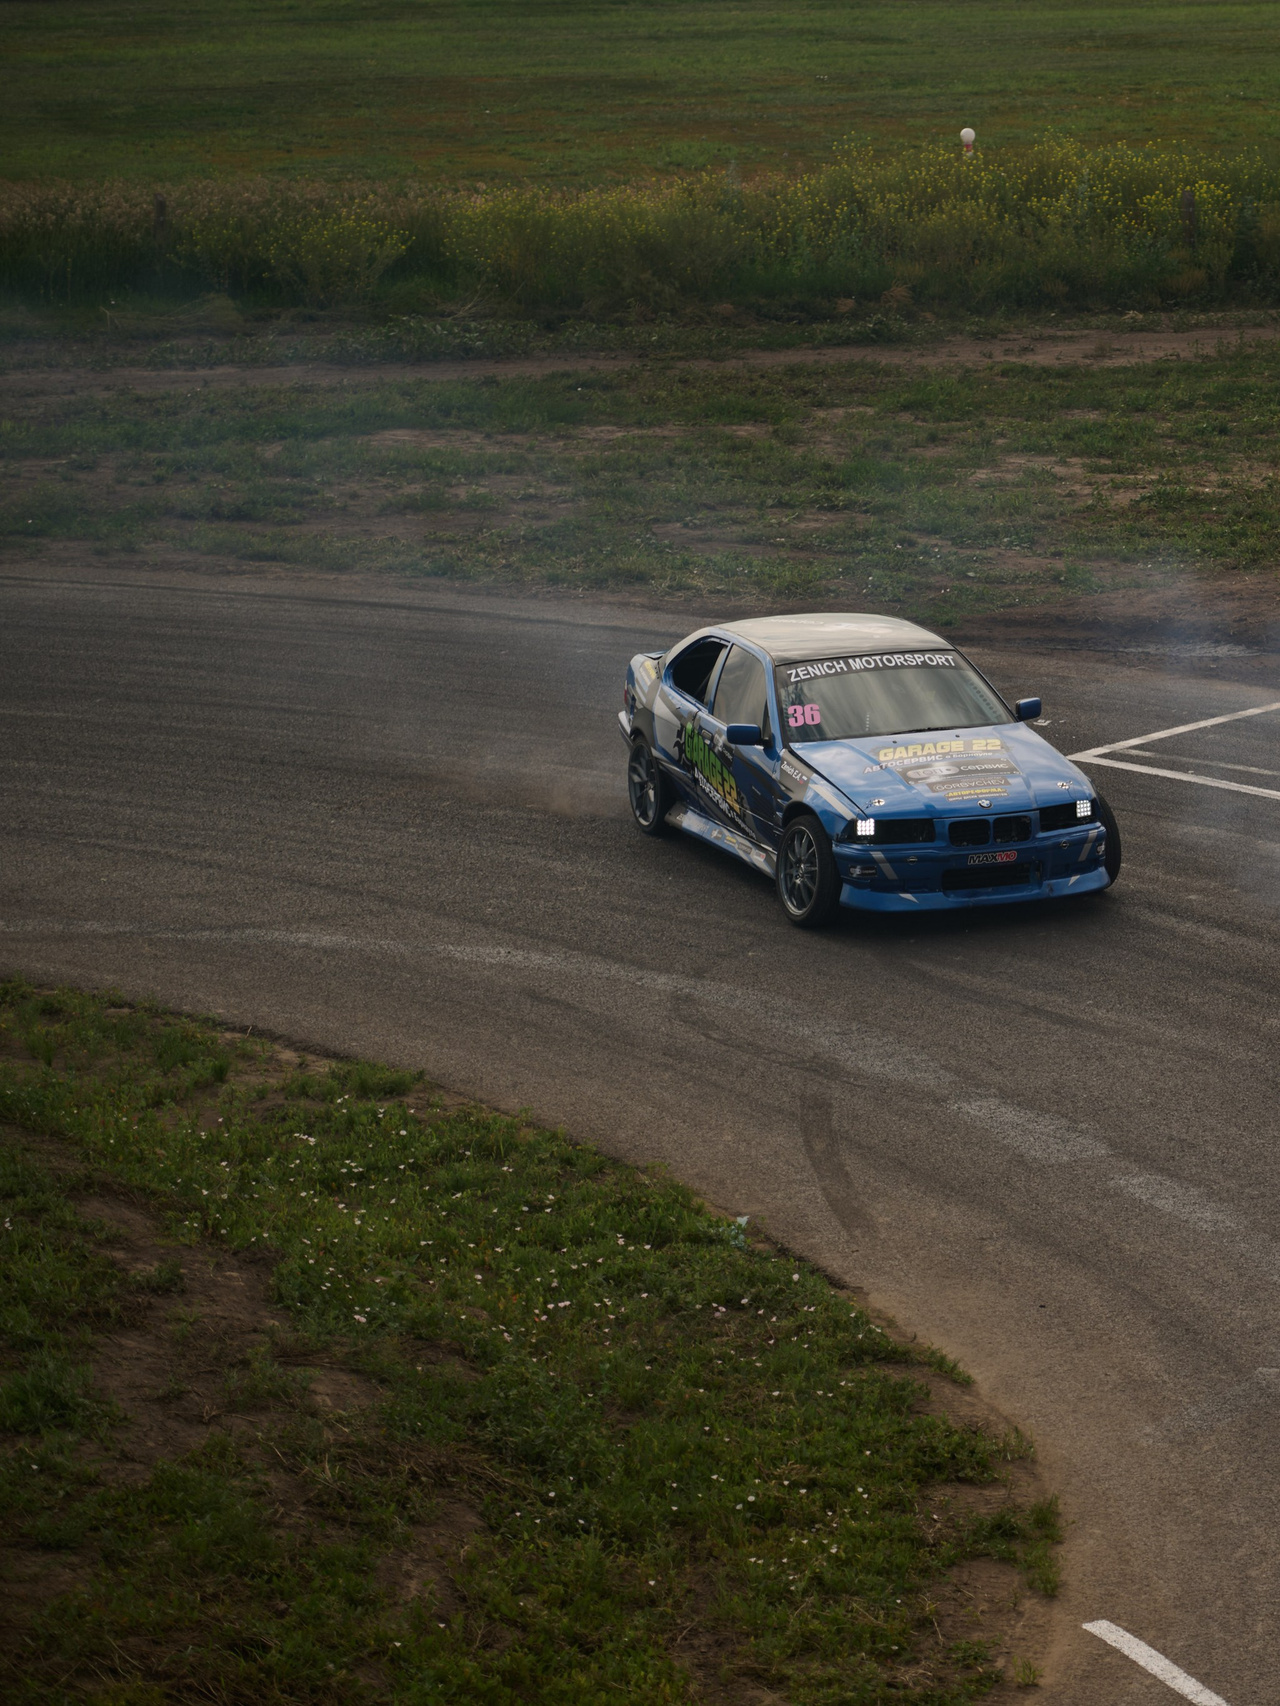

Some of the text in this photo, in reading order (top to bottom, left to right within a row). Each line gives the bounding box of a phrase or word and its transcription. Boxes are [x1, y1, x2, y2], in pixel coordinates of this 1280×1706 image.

[787, 653, 956, 682] ZENICH MOTORSPORT
[787, 703, 821, 727] 36
[685, 721, 725, 800] GARAGE
[878, 738, 1001, 761] GARAGE 22
[864, 754, 943, 774] АВТОСЕРВИС
[960, 762, 1009, 772] сервис
